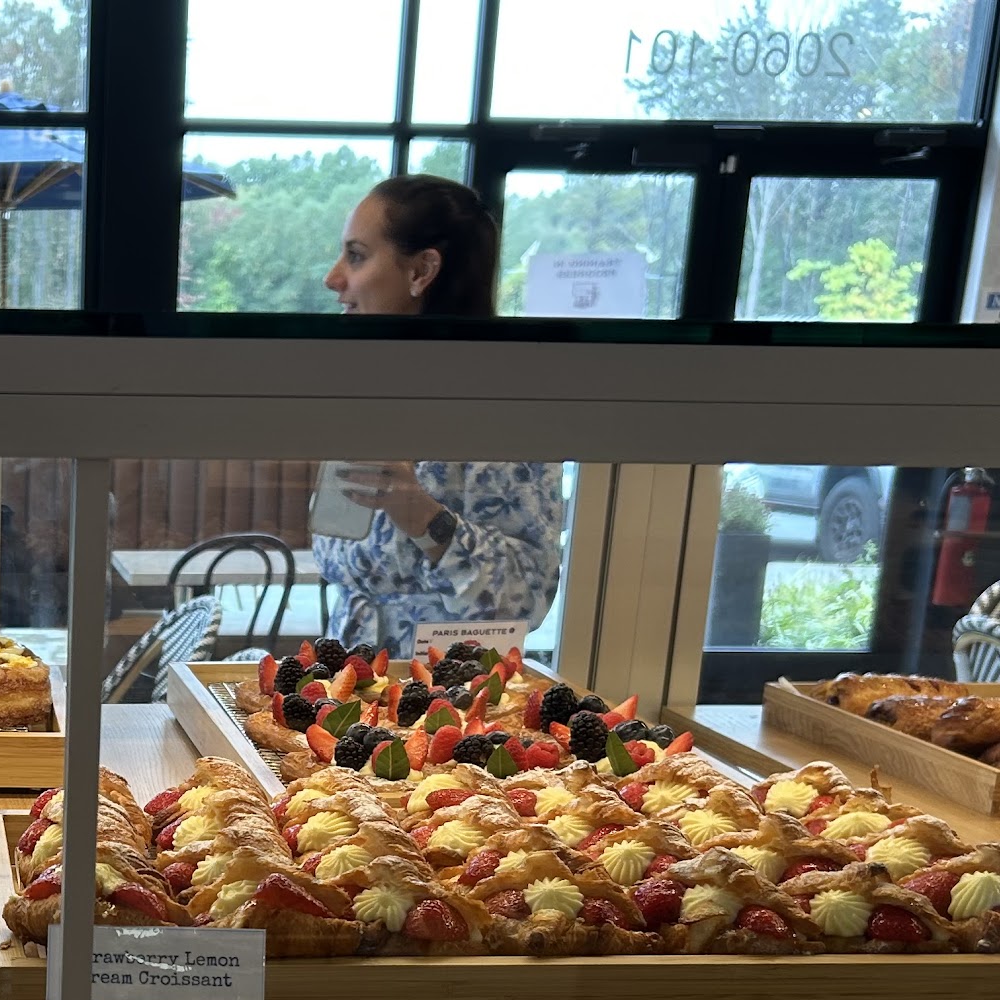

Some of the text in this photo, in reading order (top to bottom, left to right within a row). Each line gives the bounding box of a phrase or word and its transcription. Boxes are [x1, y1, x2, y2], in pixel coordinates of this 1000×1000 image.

[432, 628, 508, 637] PARIS BAGUETTE
[91, 951, 240, 967] rawberry Lemon
[91, 970, 232, 988] ream Croissant
